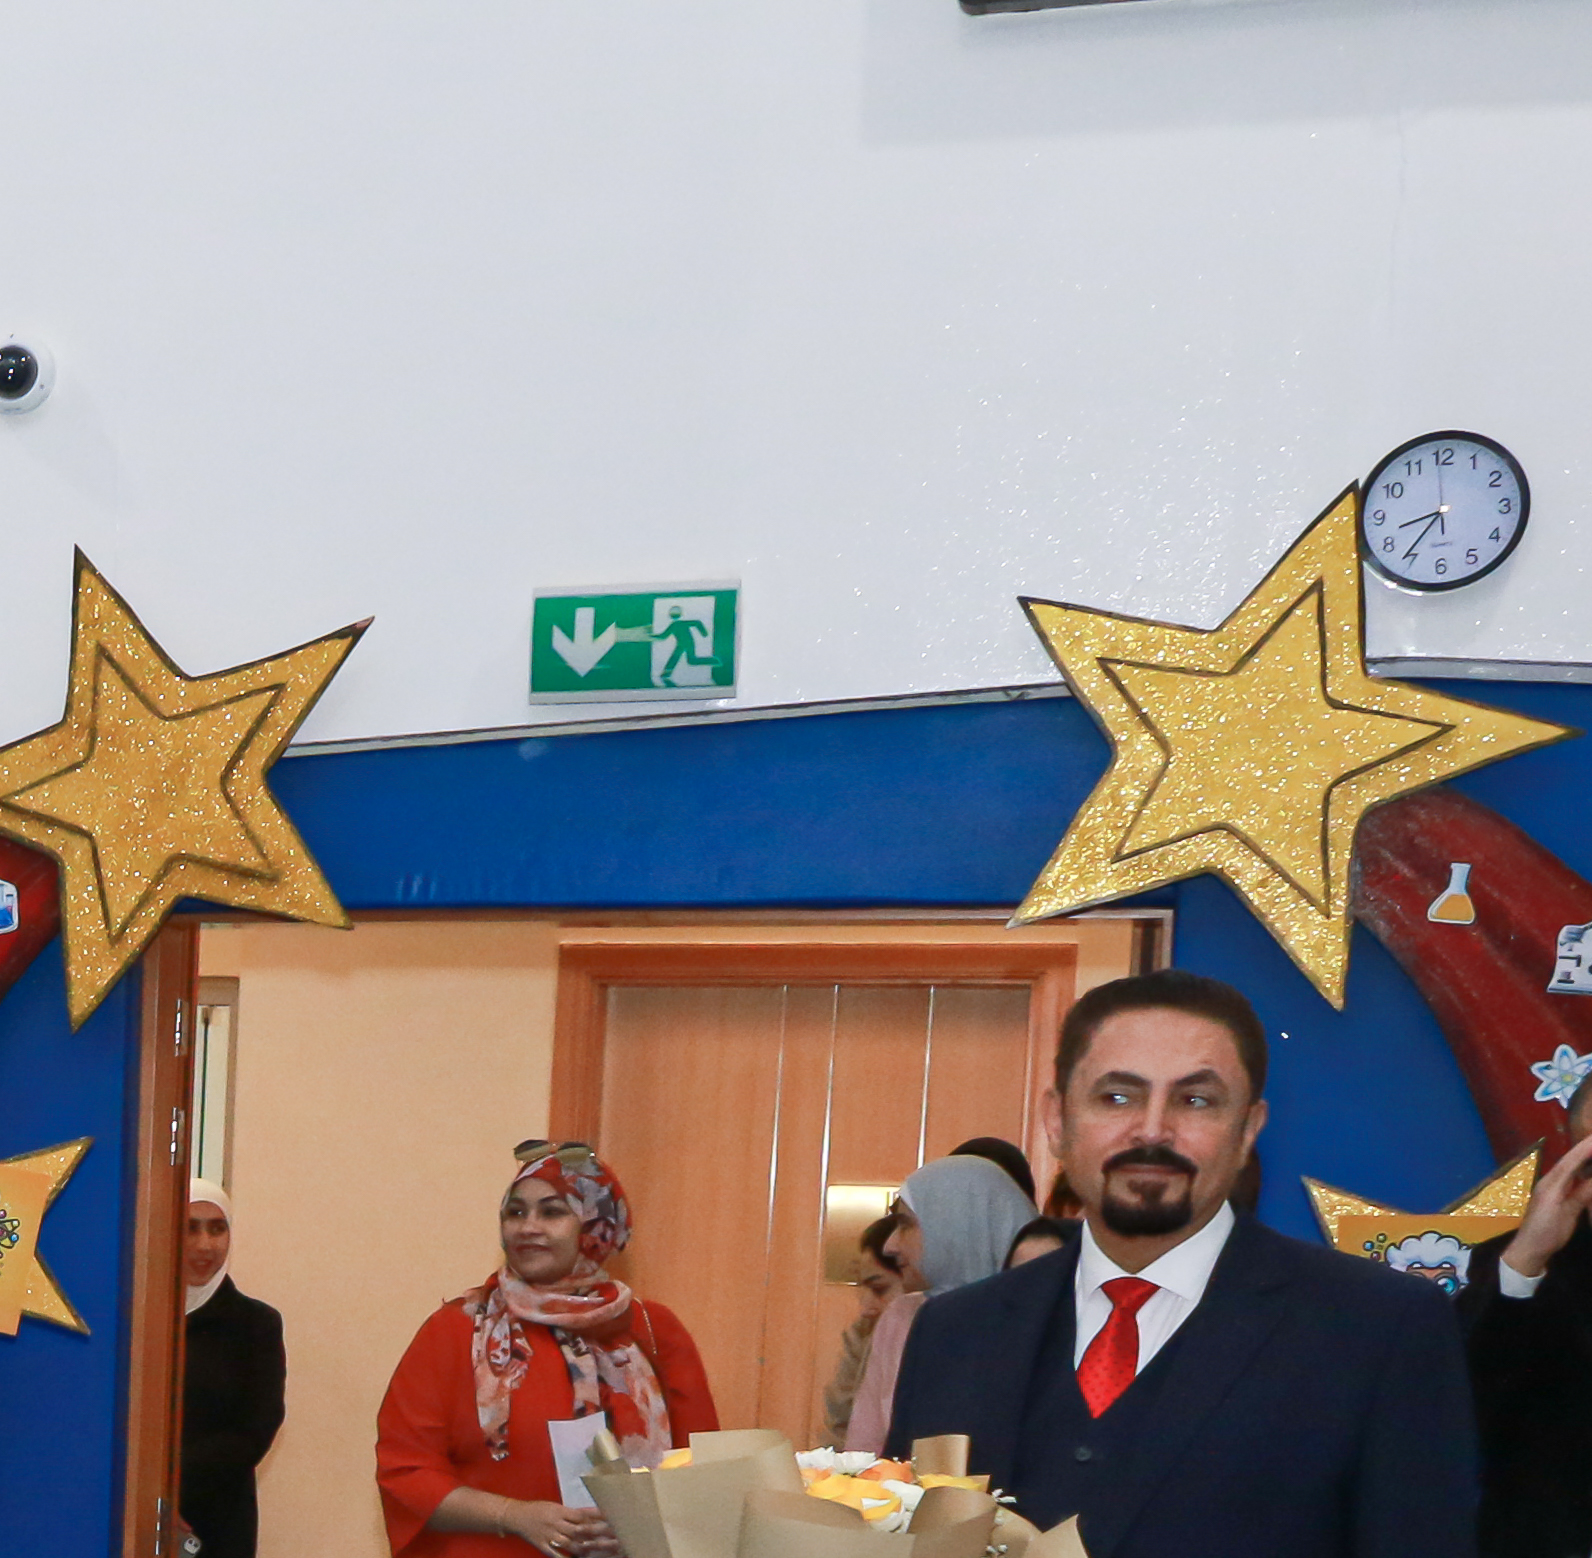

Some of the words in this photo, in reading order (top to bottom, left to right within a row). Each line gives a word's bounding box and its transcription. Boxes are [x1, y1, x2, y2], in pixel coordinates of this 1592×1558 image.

[1431, 448, 1455, 467] 12
[1469, 453, 1477, 471] 1
[1404, 458, 1423, 477] 11
[1488, 470, 1503, 488] 2
[1382, 482, 1404, 499] 10
[1498, 497, 1512, 515] 3
[1373, 509, 1386, 526] 9
[1488, 527, 1501, 543] 4
[1382, 536, 1395, 553] 8
[1465, 548, 1479, 565] 5
[1434, 558, 1447, 575] 6
